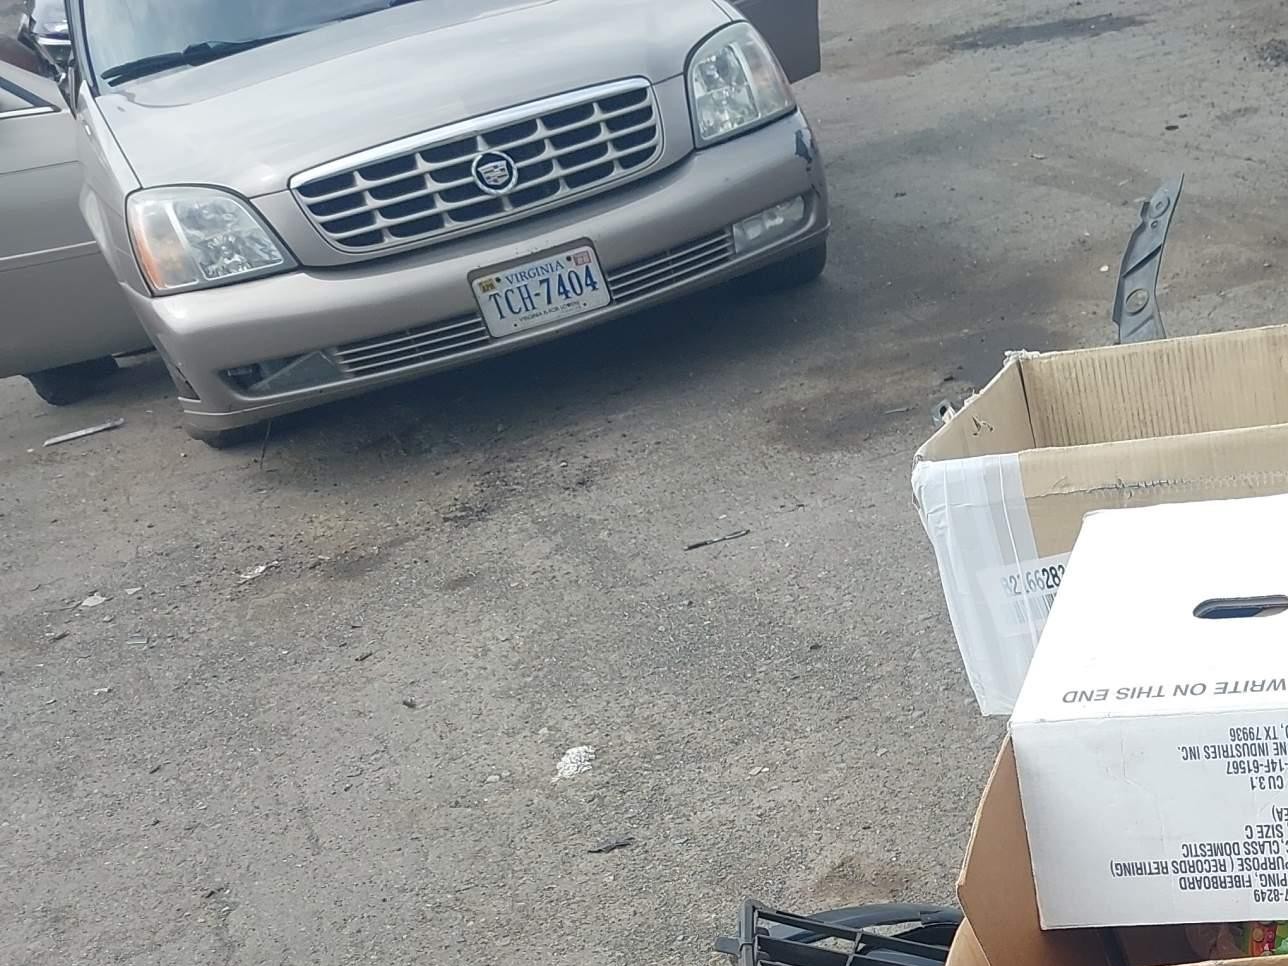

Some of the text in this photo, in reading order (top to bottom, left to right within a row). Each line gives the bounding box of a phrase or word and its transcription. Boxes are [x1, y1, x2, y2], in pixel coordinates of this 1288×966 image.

[505, 261, 564, 285] VIRGINIA
[489, 265, 599, 320] TCH-7404
[1116, 685, 1165, 700] THIS
[1173, 683, 1207, 697] ON
[1213, 678, 1287, 695] WRITE
[1062, 689, 1109, 703] END
[1229, 726, 1262, 742] 79936
[1265, 726, 1277, 740] TX
[1178, 744, 1201, 761] INC.
[1204, 742, 1269, 760] INDUSTRIES
[1250, 776, 1266, 791] 3.1
[1268, 775, 1284, 789] CU
[1245, 824, 1253, 839] C
[1258, 823, 1284, 839] SIZE
[1181, 842, 1241, 858] DOMESTIC
[1110, 860, 1169, 877] RETIRING)
[1179, 874, 1252, 890] FIBERBOARD
